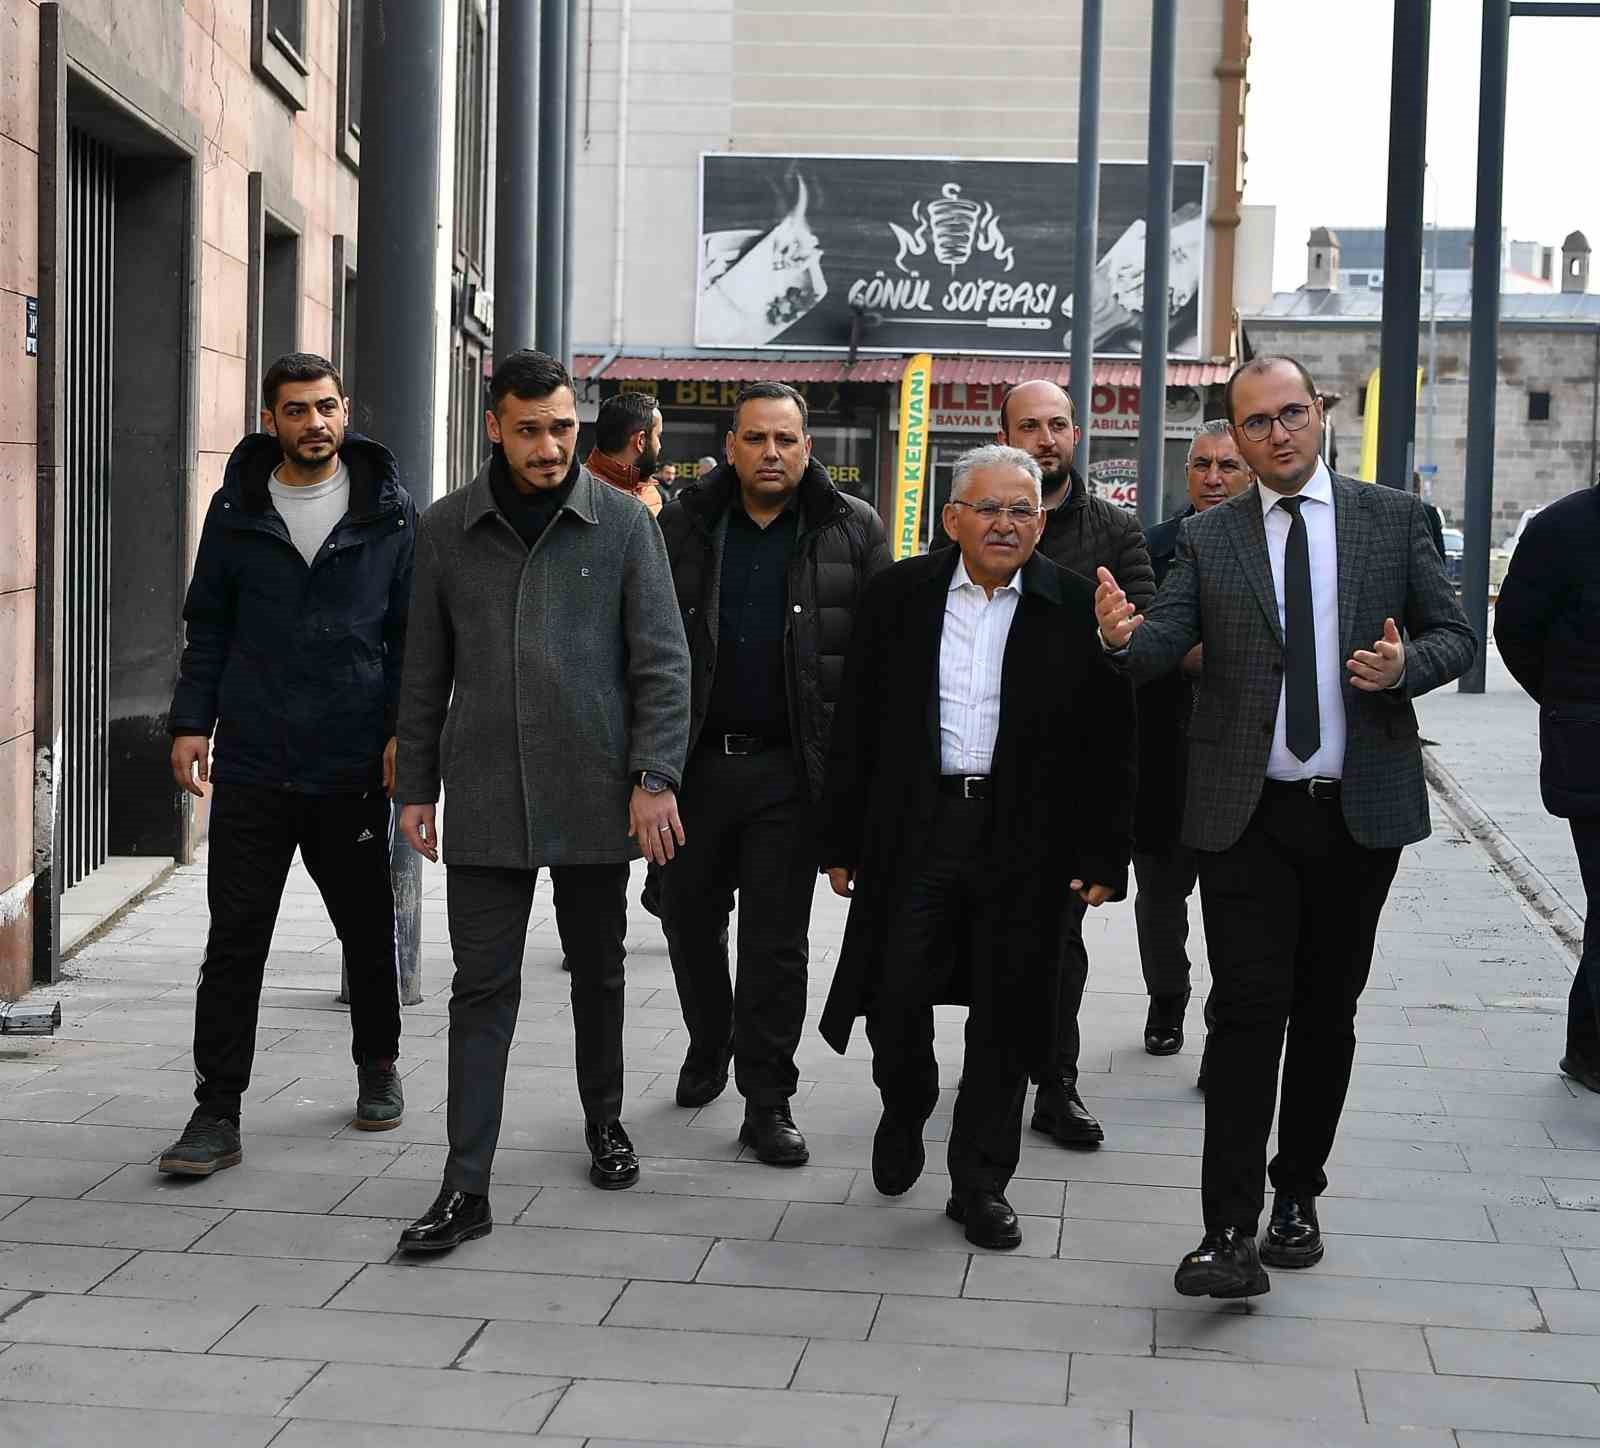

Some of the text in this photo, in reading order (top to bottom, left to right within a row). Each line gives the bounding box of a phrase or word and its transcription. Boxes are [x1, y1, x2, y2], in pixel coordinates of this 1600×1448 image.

[675, 382, 740, 405] BER
[904, 371, 925, 480] KERVANI
[936, 415, 980, 426] BAYAN
